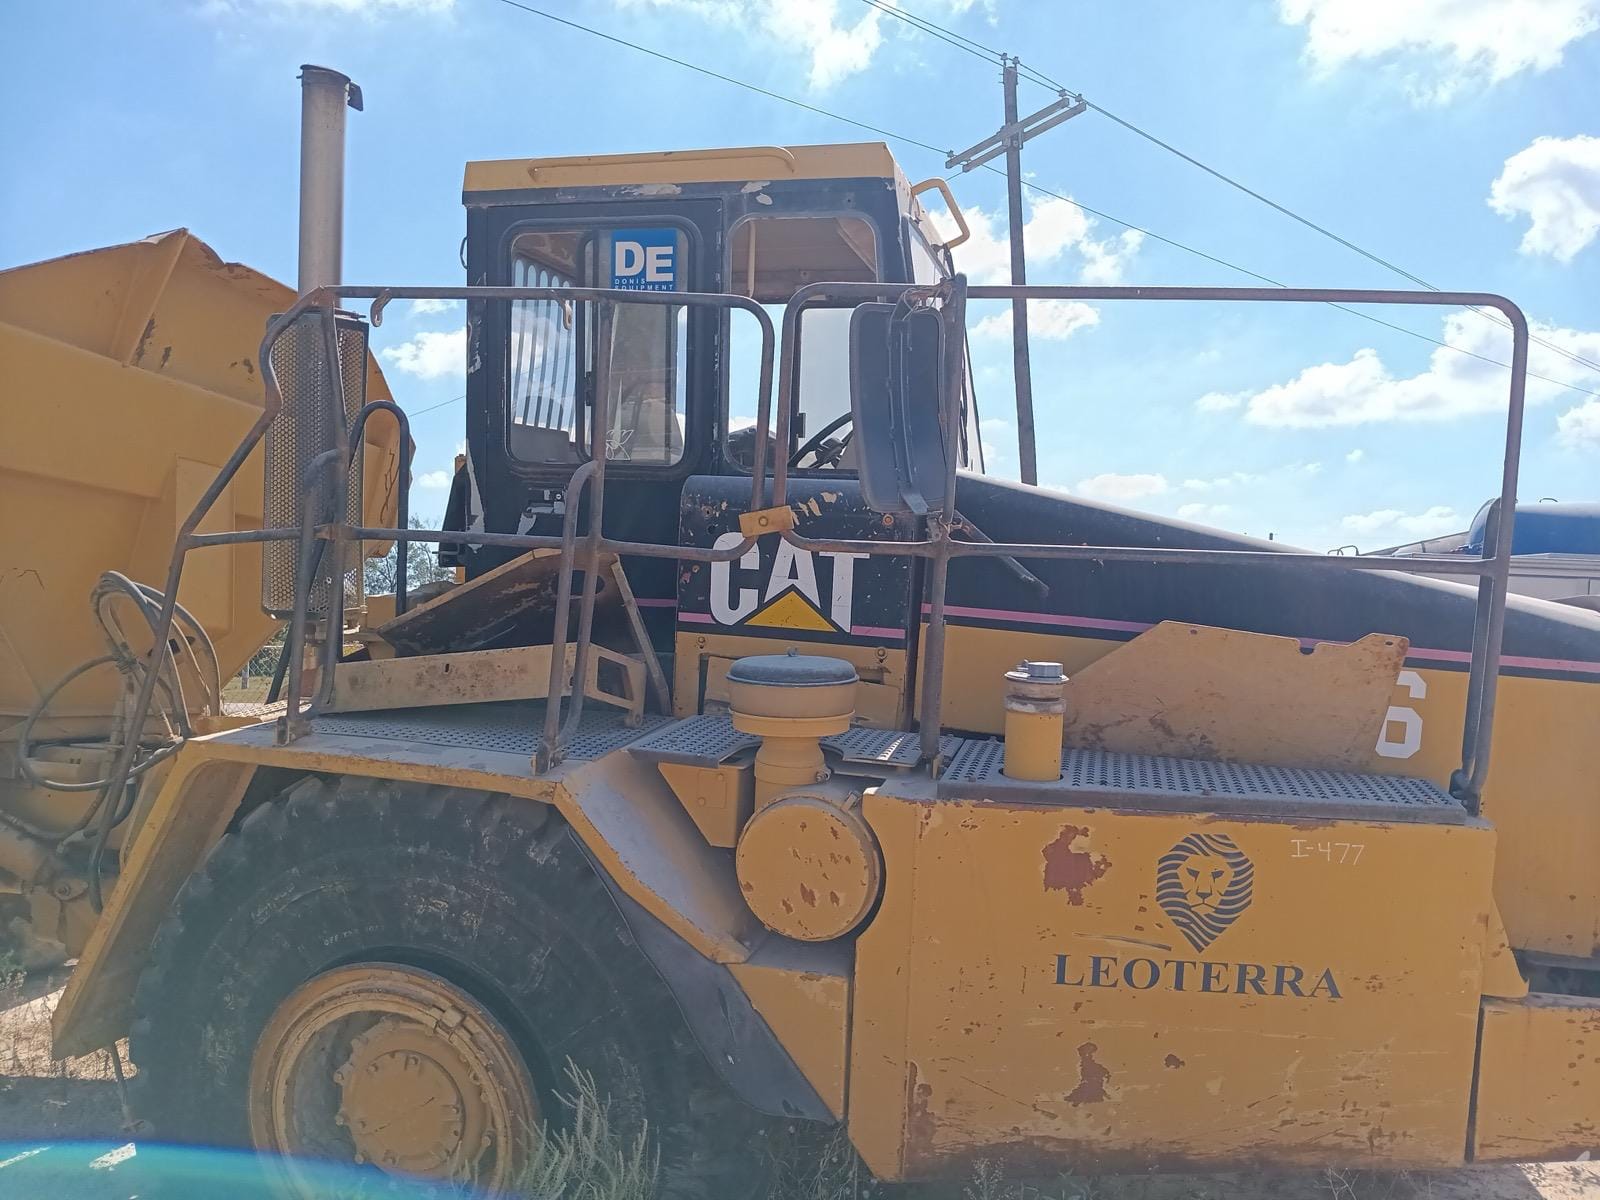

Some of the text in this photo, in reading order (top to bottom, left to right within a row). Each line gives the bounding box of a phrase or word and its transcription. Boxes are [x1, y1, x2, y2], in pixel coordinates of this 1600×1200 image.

[615, 241, 674, 282] DE
[710, 531, 870, 633] CAT
[1290, 839, 1365, 866] I-477
[1051, 953, 1344, 999] LEOTERRA
